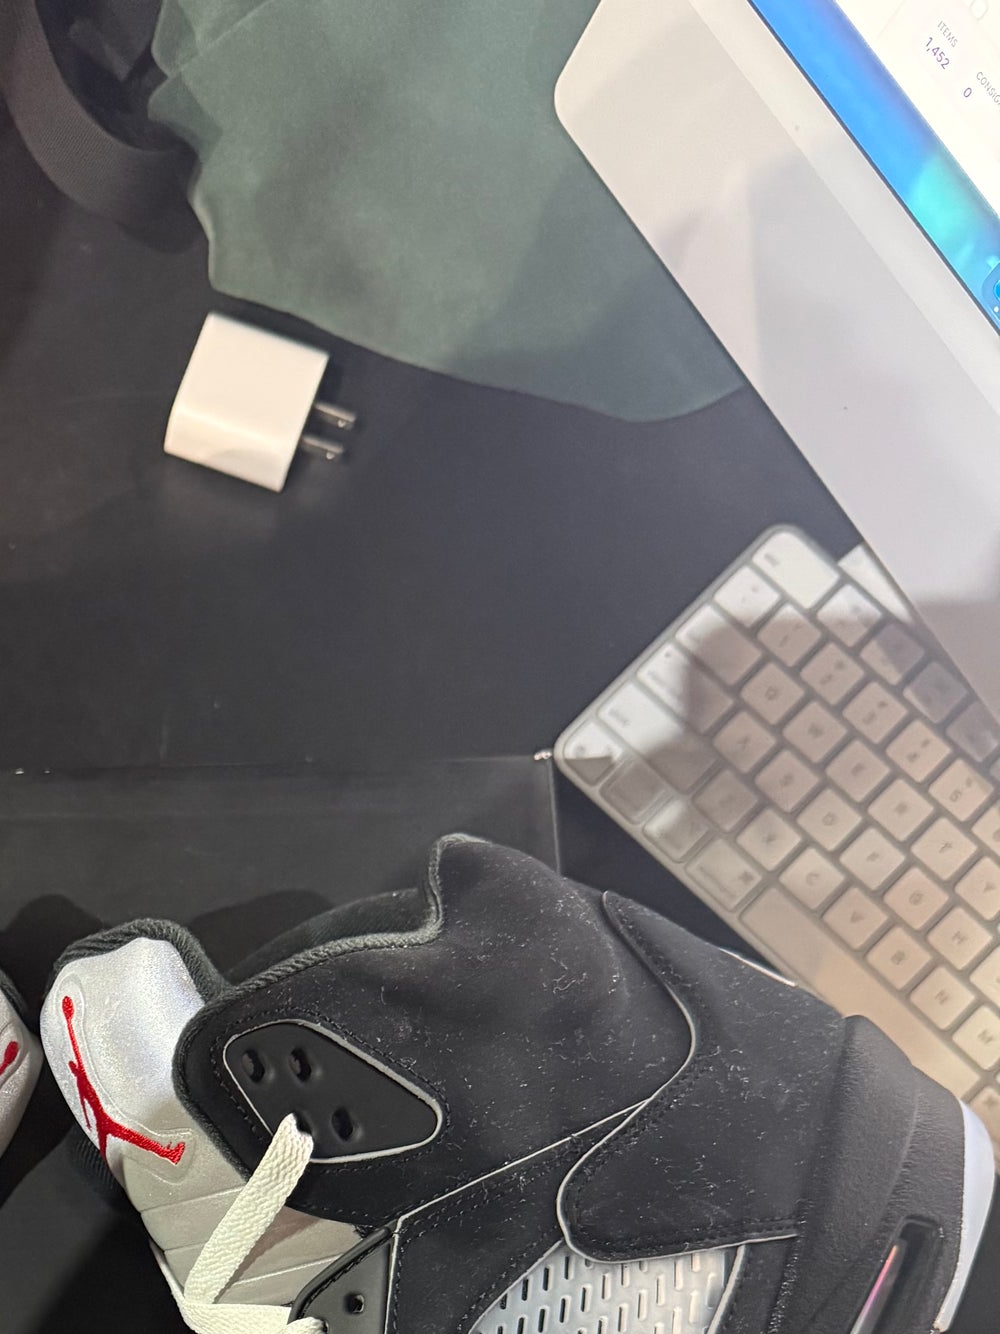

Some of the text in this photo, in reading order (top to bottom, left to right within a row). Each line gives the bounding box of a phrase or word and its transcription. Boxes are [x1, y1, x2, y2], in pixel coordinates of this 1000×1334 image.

[937, 20, 958, 48] ITEMS
[925, 36, 950, 70] 1,452
[976, 71, 1000, 105] CONSIG
